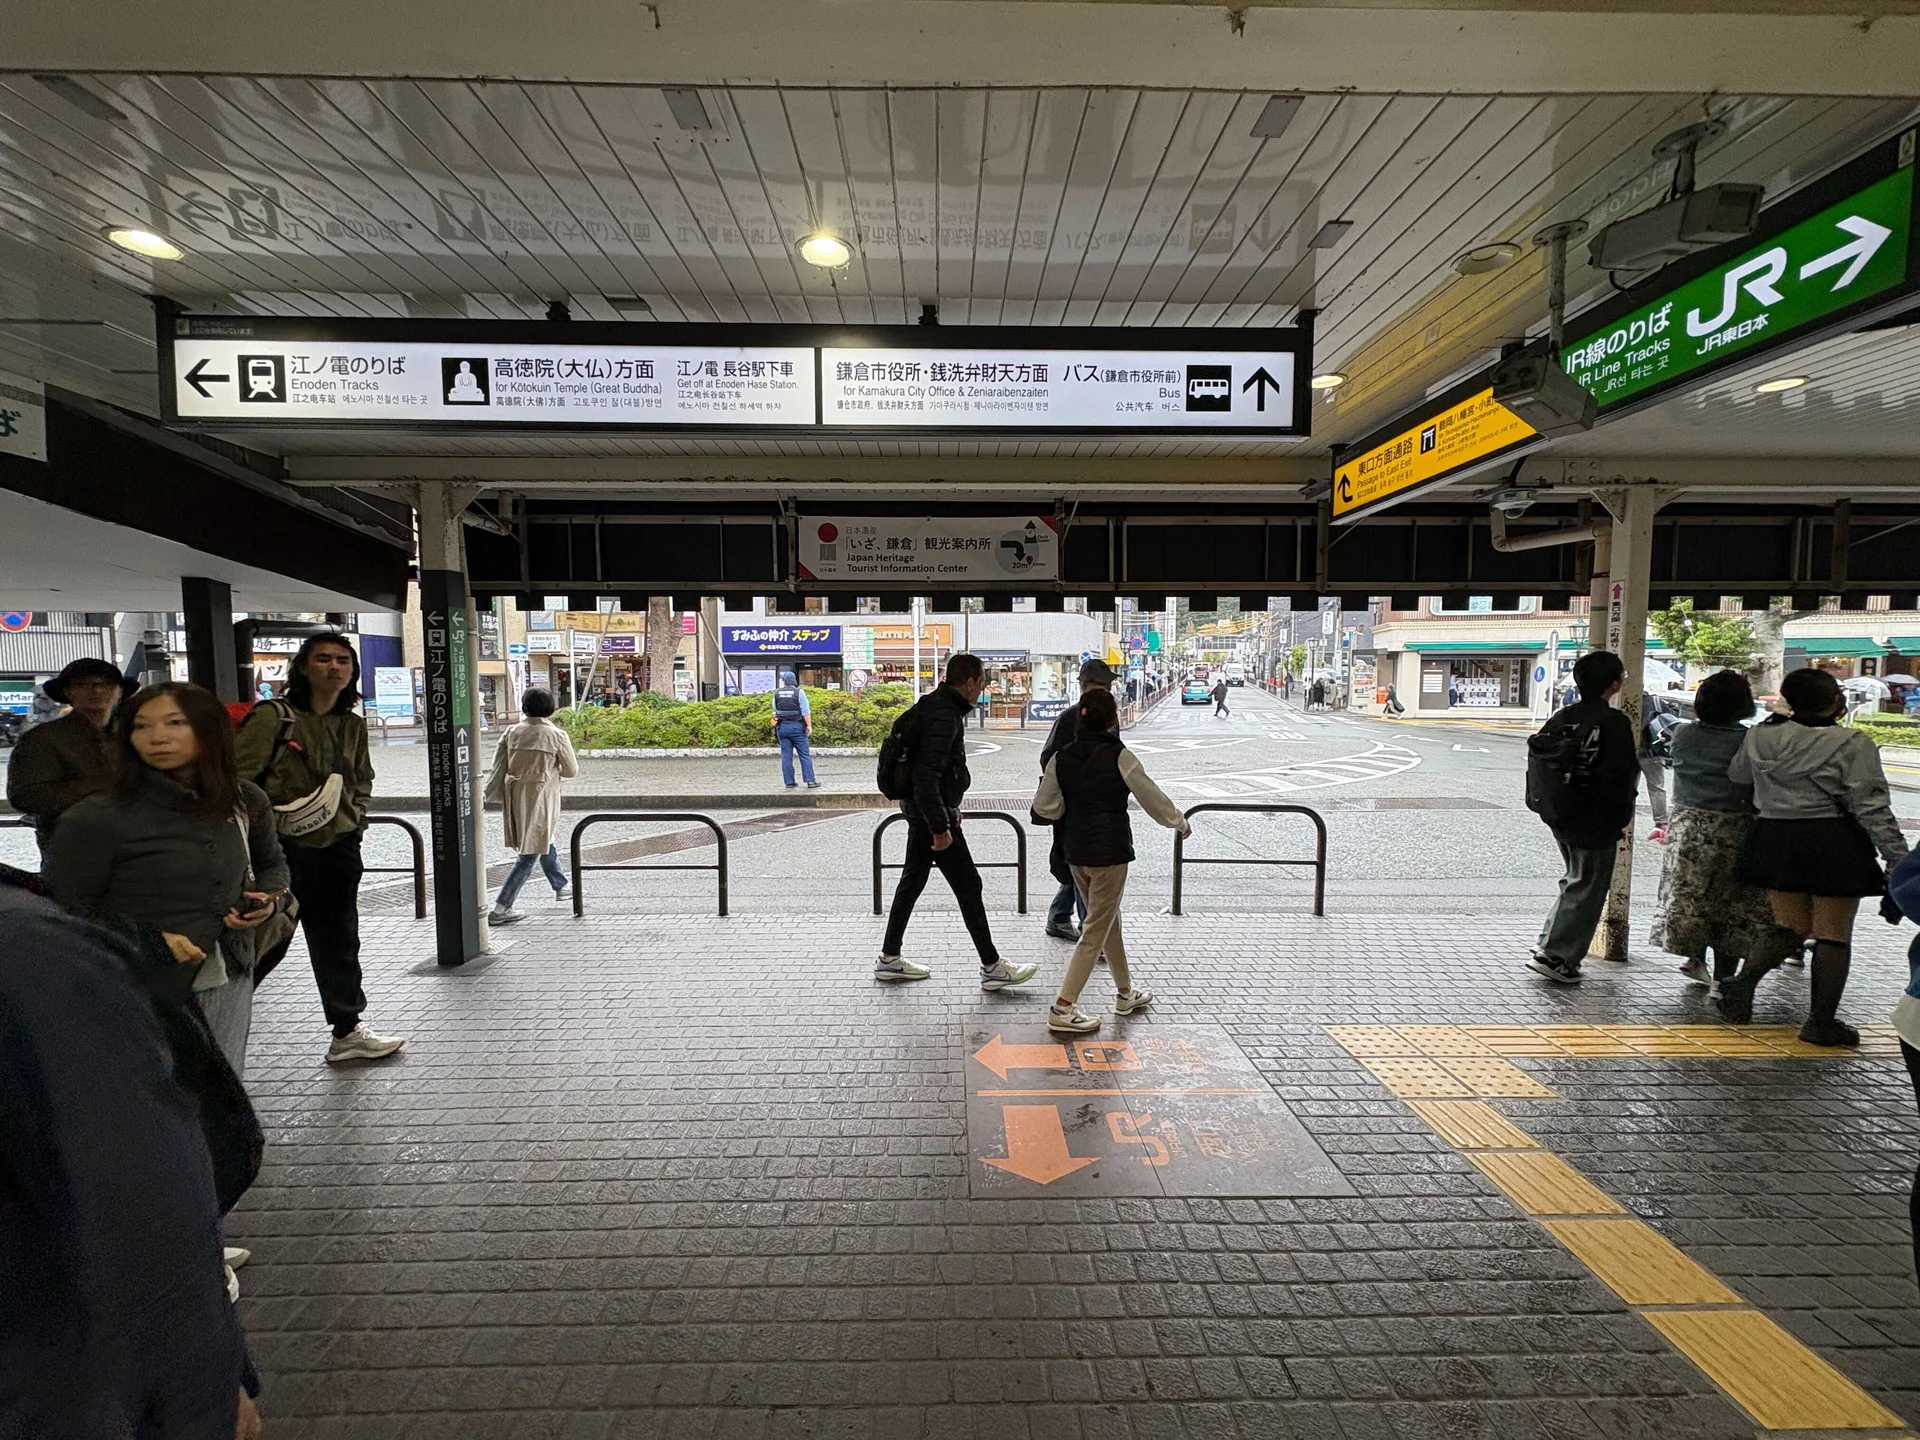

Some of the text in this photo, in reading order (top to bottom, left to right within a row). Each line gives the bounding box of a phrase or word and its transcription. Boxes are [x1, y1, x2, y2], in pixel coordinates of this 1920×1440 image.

[1687, 247, 1787, 337] JR
[1696, 313, 1770, 355] JR東日本
[291, 355, 406, 375] 江ノ電のりば
[1595, 361, 1620, 381] Line
[1624, 338, 1671, 366] Tracks
[494, 358, 654, 379] 高徳院(大仏)方面
[677, 360, 794, 377] 江ノ電 長谷駅下車
[836, 362, 1048, 383] 鎌倉市役所・銭洗弁財天方面
[1631, 364, 1653, 379] 타는
[291, 379, 379, 390] Enoden Tracks
[495, 382, 507, 393] for
[554, 382, 588, 395] Temple
[590, 382, 620, 395] (Great
[623, 383, 662, 395] Buddha)
[677, 379, 799, 389] Get off at Enoden Hase Station.
[843, 385, 1049, 399] for Kamakura City Office & Zeniaraibenzaiten
[1160, 388, 1180, 398] Bus
[1116, 402, 1154, 412] 公共汽车
[1162, 402, 1180, 412] 버스
[1358, 437, 1413, 477] 東口方面通路
[1357, 457, 1412, 489] Passage to East Exit
[846, 526, 877, 534] 日本遺産
[925, 537, 992, 550] 観光案内所
[847, 553, 915, 563] Japan Heritage
[847, 564, 968, 573] Tourist Information Center
[731, 629, 830, 642] すみふの仲介 ステップ
[431, 649, 448, 734] 江ノ電のりば
[442, 743, 452, 807] Enoden Tracks
[1105, 1111, 1170, 1166] JR
